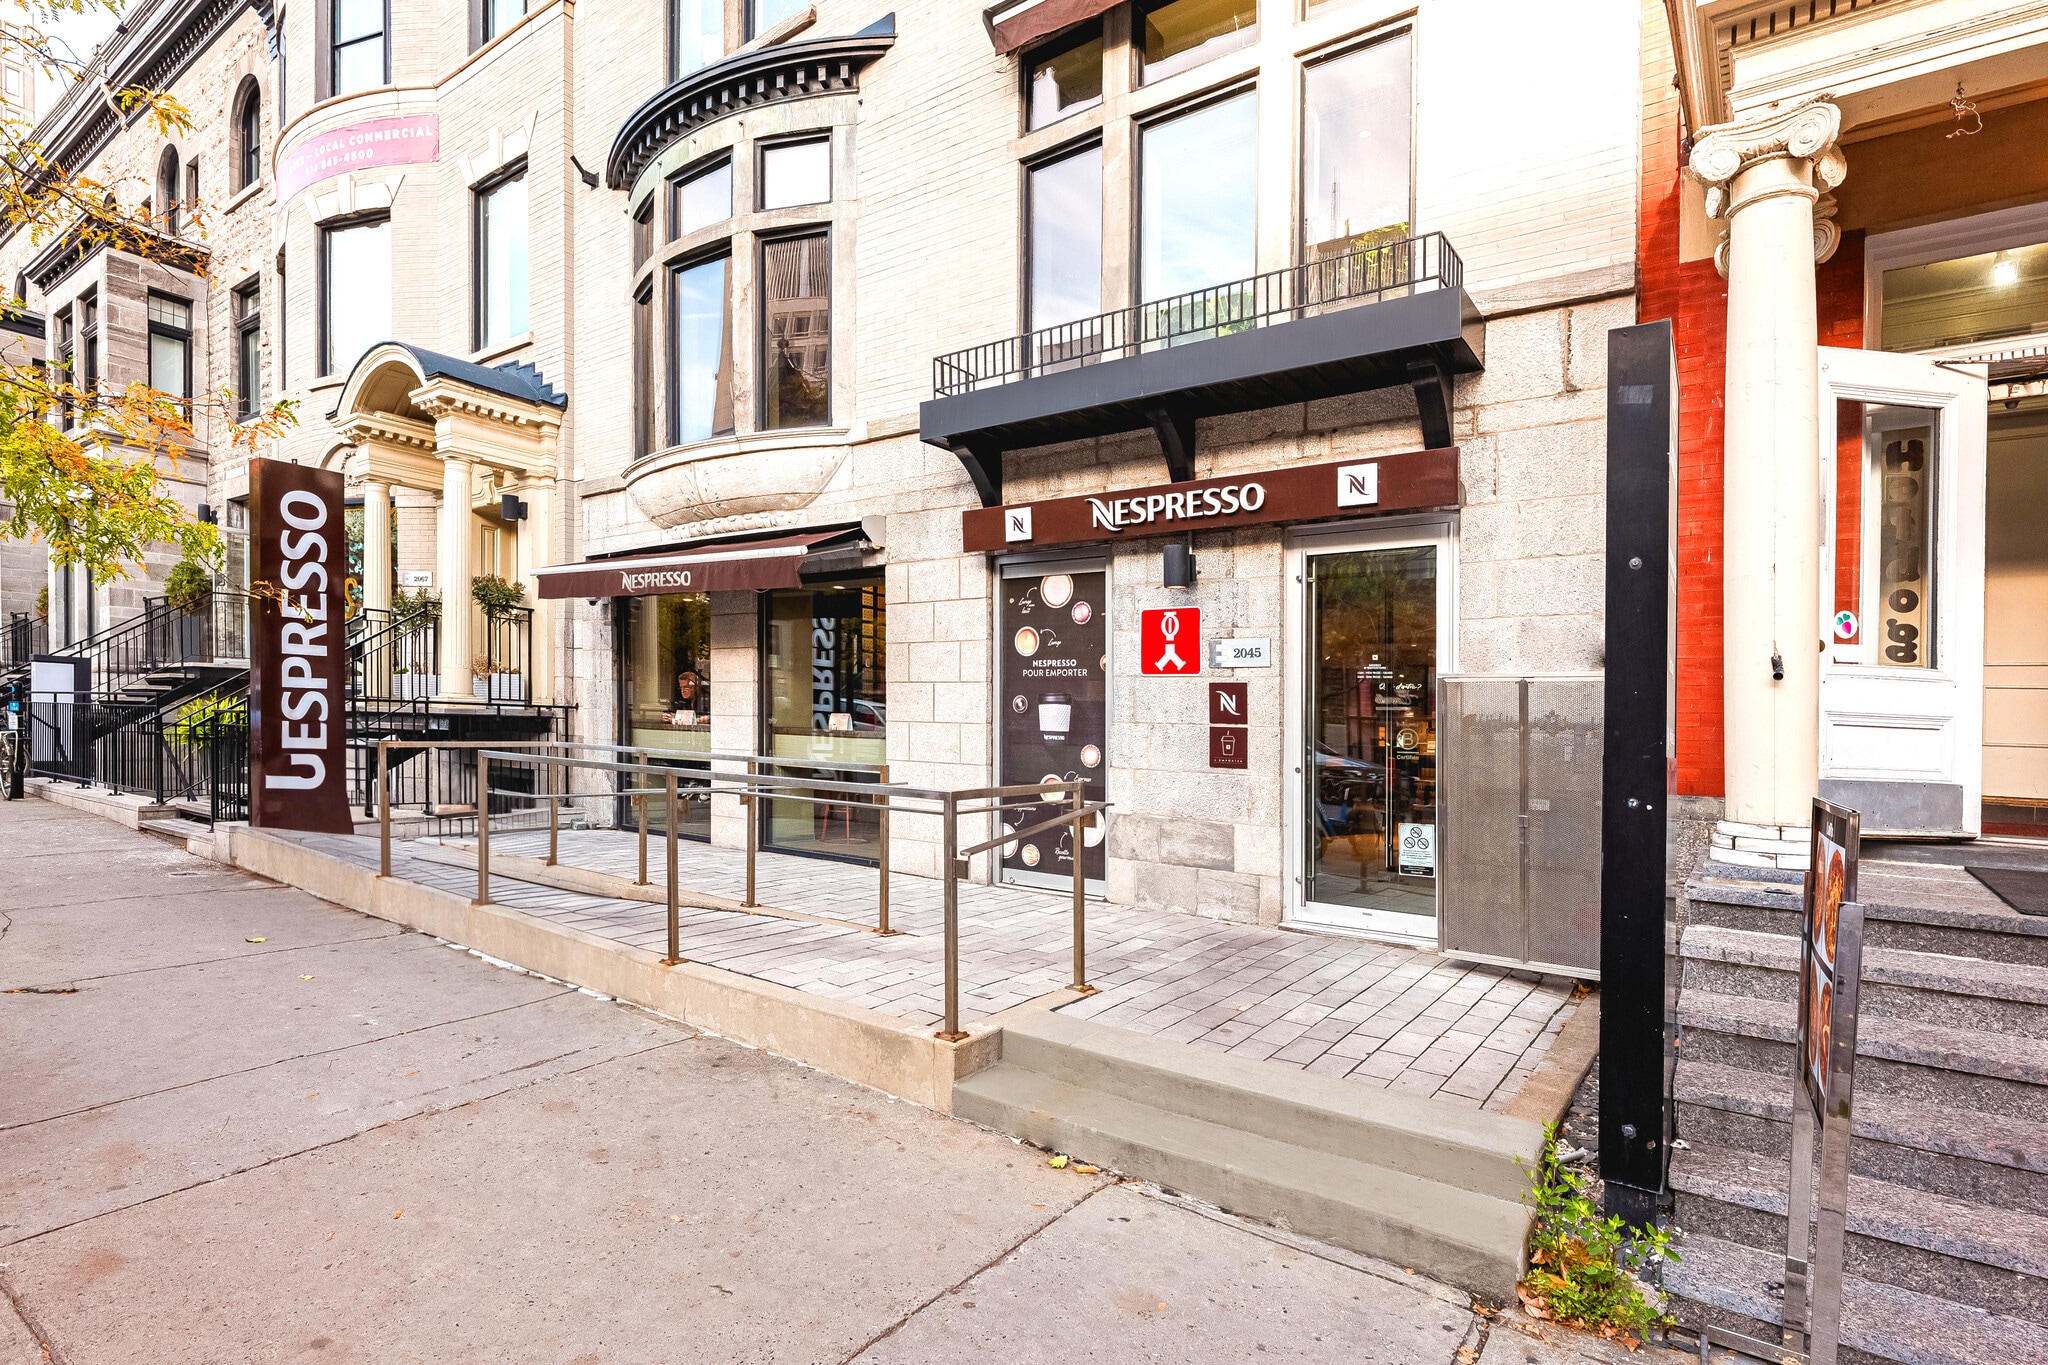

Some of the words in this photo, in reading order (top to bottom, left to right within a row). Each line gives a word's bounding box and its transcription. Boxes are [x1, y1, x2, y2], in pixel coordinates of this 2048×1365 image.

[315, 138, 345, 158] LOCAL
[349, 126, 433, 146] COMMERCIAL
[1085, 483, 1265, 532] NESPRESSO
[619, 570, 691, 593] NESPRESSO
[1233, 647, 1262, 658] 2045
[1032, 659, 1077, 667] NESPRESSO
[1022, 669, 1044, 677] POUR
[1045, 669, 1088, 677] EMPORTER
